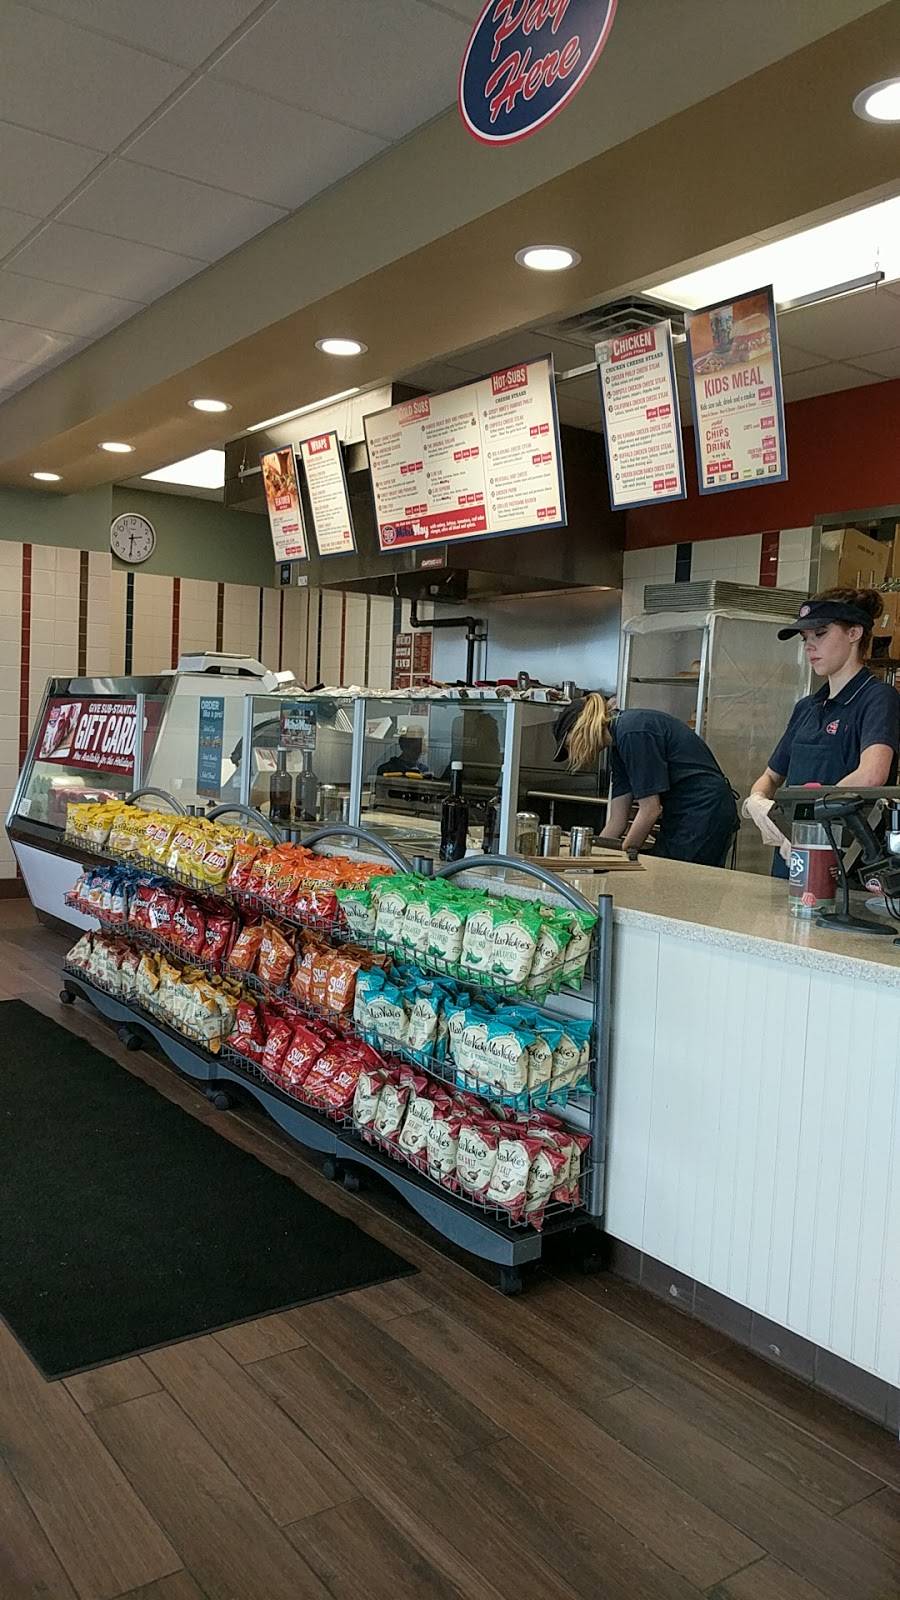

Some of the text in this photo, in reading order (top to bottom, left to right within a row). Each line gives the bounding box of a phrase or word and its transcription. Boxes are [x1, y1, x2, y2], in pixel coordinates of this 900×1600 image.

[491, 0, 571, 62] Pay
[485, 36, 581, 123] Here
[613, 332, 652, 356] CHICKEN
[493, 368, 526, 392] HOT SUBS
[704, 366, 764, 399] KIDS MEAL
[706, 427, 729, 441] CHIPS
[706, 440, 732, 454] DRINK
[89, 703, 137, 715] GIVE SUB-STANTIA
[201, 700, 220, 710] ORDER
[75, 714, 108, 751] GIFT
